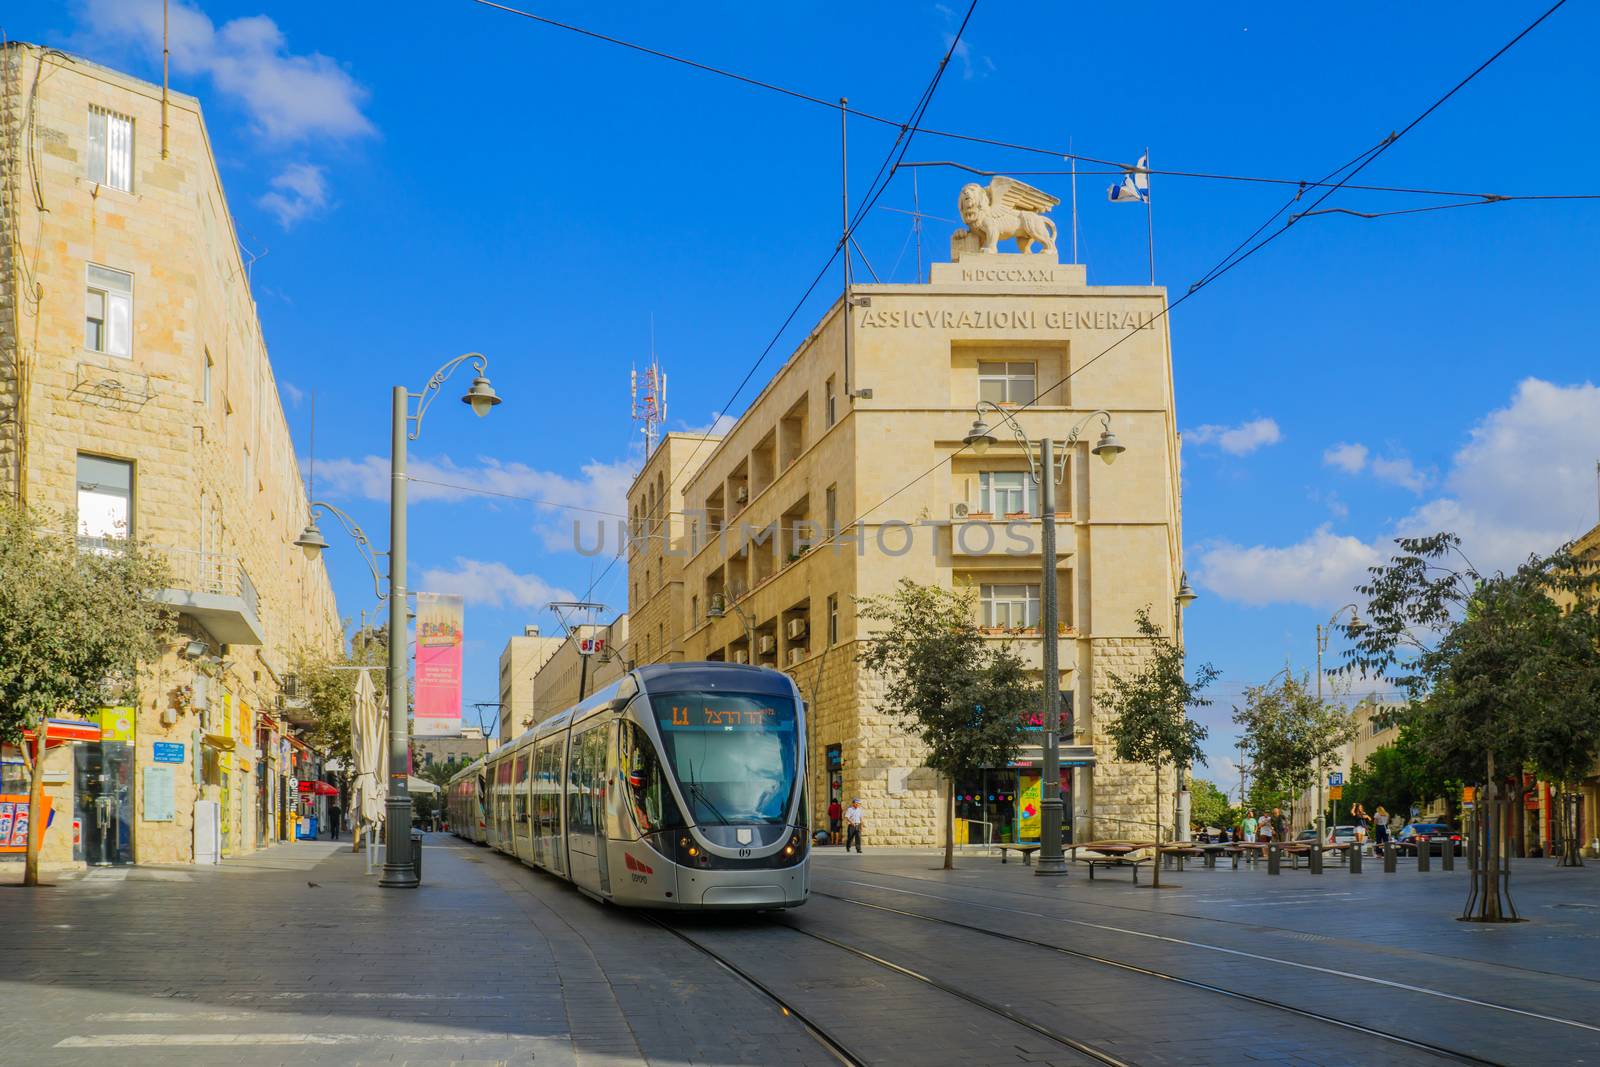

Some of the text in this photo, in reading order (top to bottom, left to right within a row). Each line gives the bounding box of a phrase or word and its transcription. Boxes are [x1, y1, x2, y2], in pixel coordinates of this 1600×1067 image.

[962, 269, 1054, 282] MDCCCXXXI
[860, 310, 1156, 330] ASSICVRAZIONI GENERALI
[671, 705, 689, 725] L1
[738, 848, 752, 858] 09
